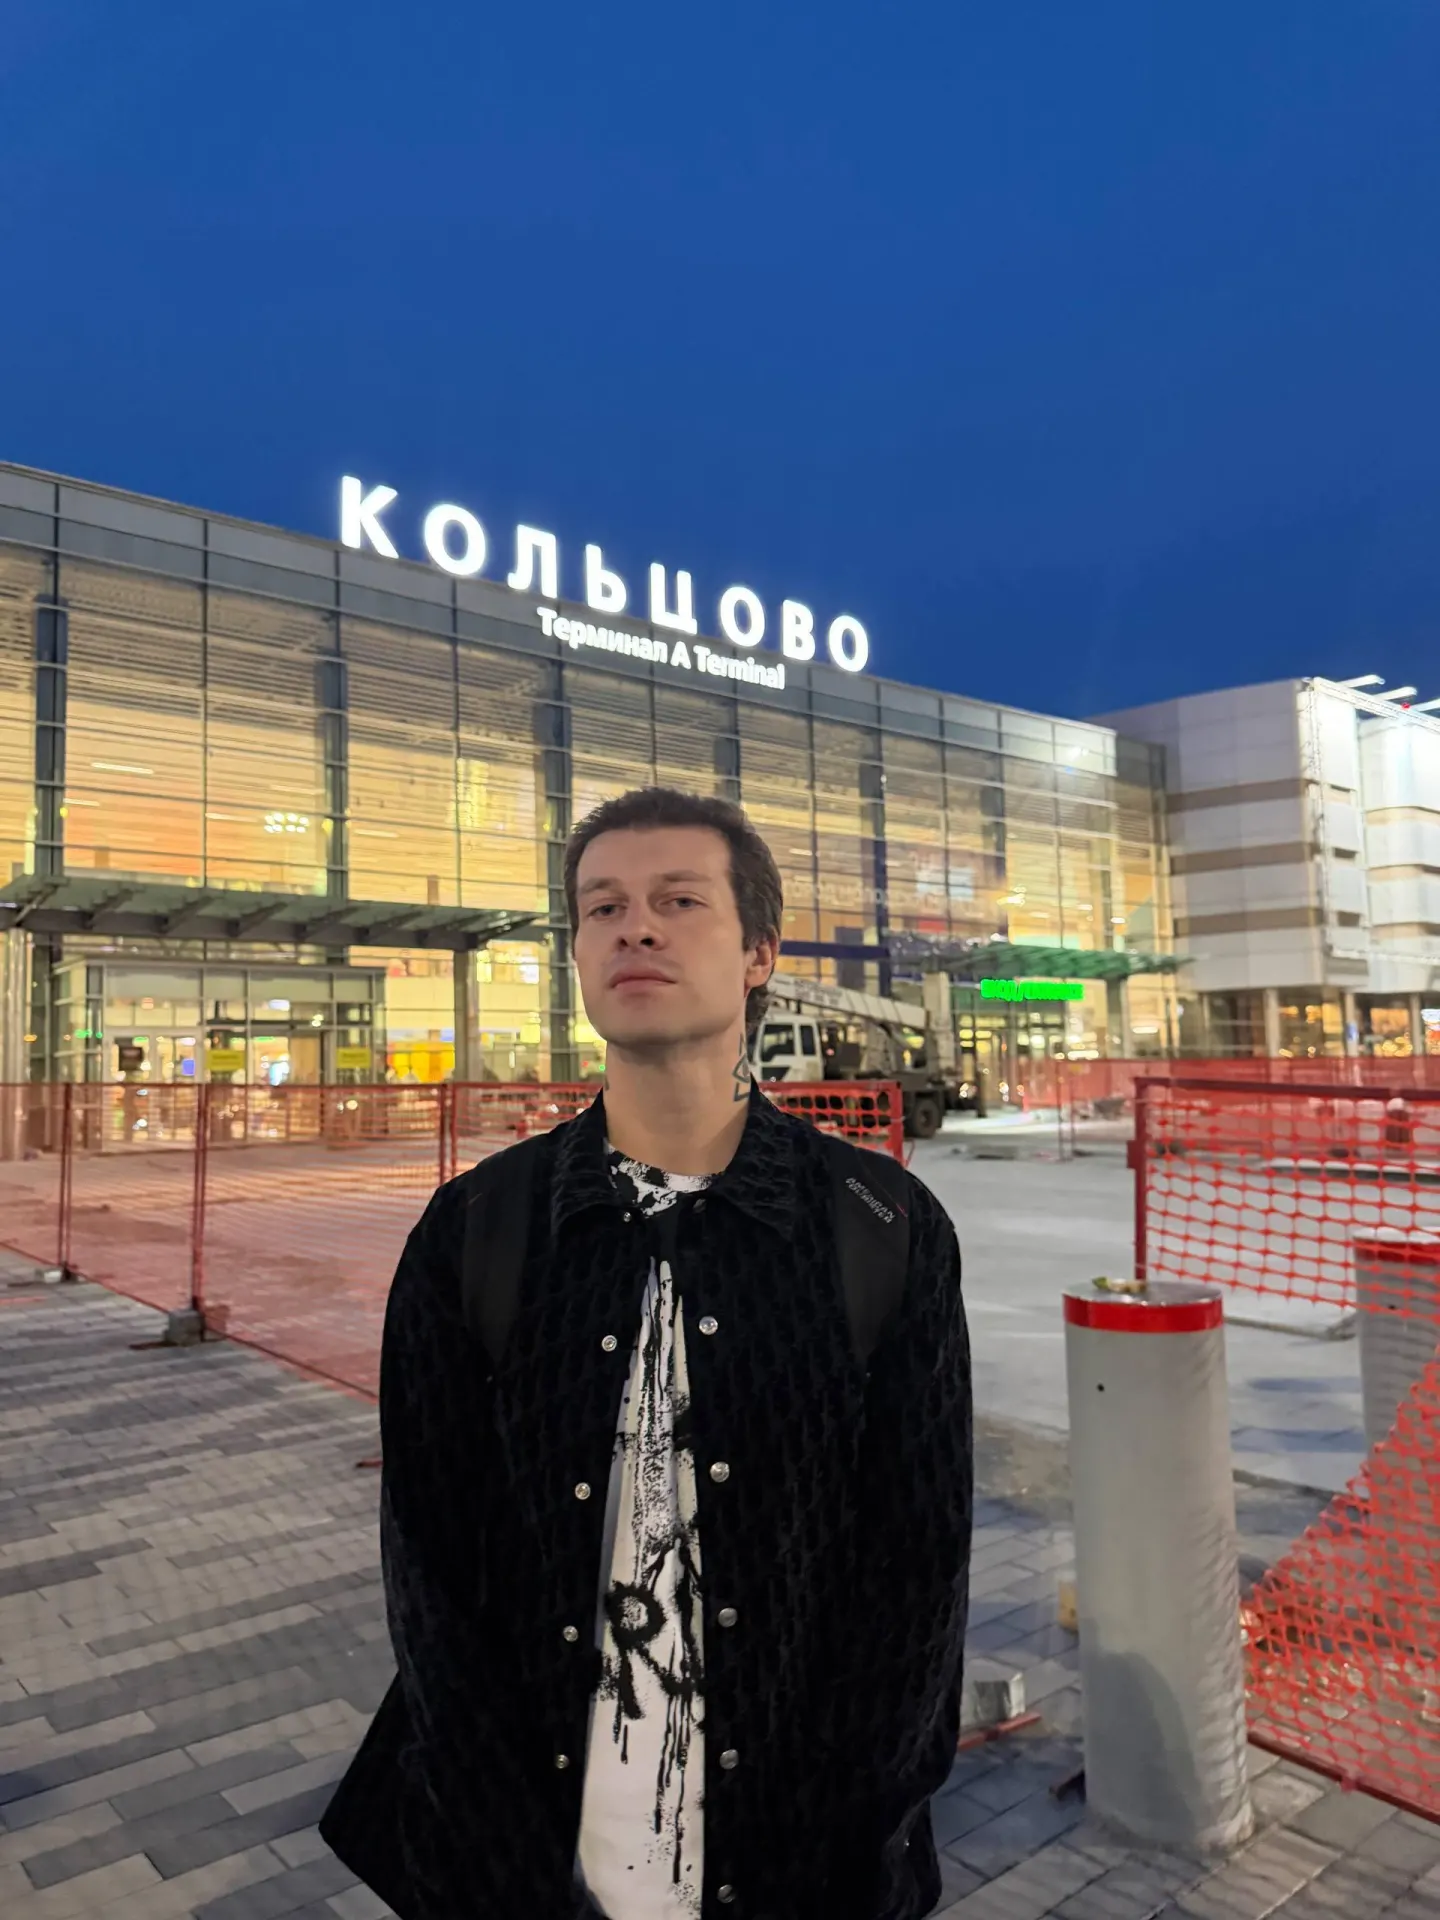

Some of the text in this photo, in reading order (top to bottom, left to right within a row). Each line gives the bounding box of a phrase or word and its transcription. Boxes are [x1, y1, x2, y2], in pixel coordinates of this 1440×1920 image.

[341, 475, 869, 674] КОЛЬЦОВО
[537, 606, 668, 664] Терминал
[693, 645, 786, 690] Terminal
